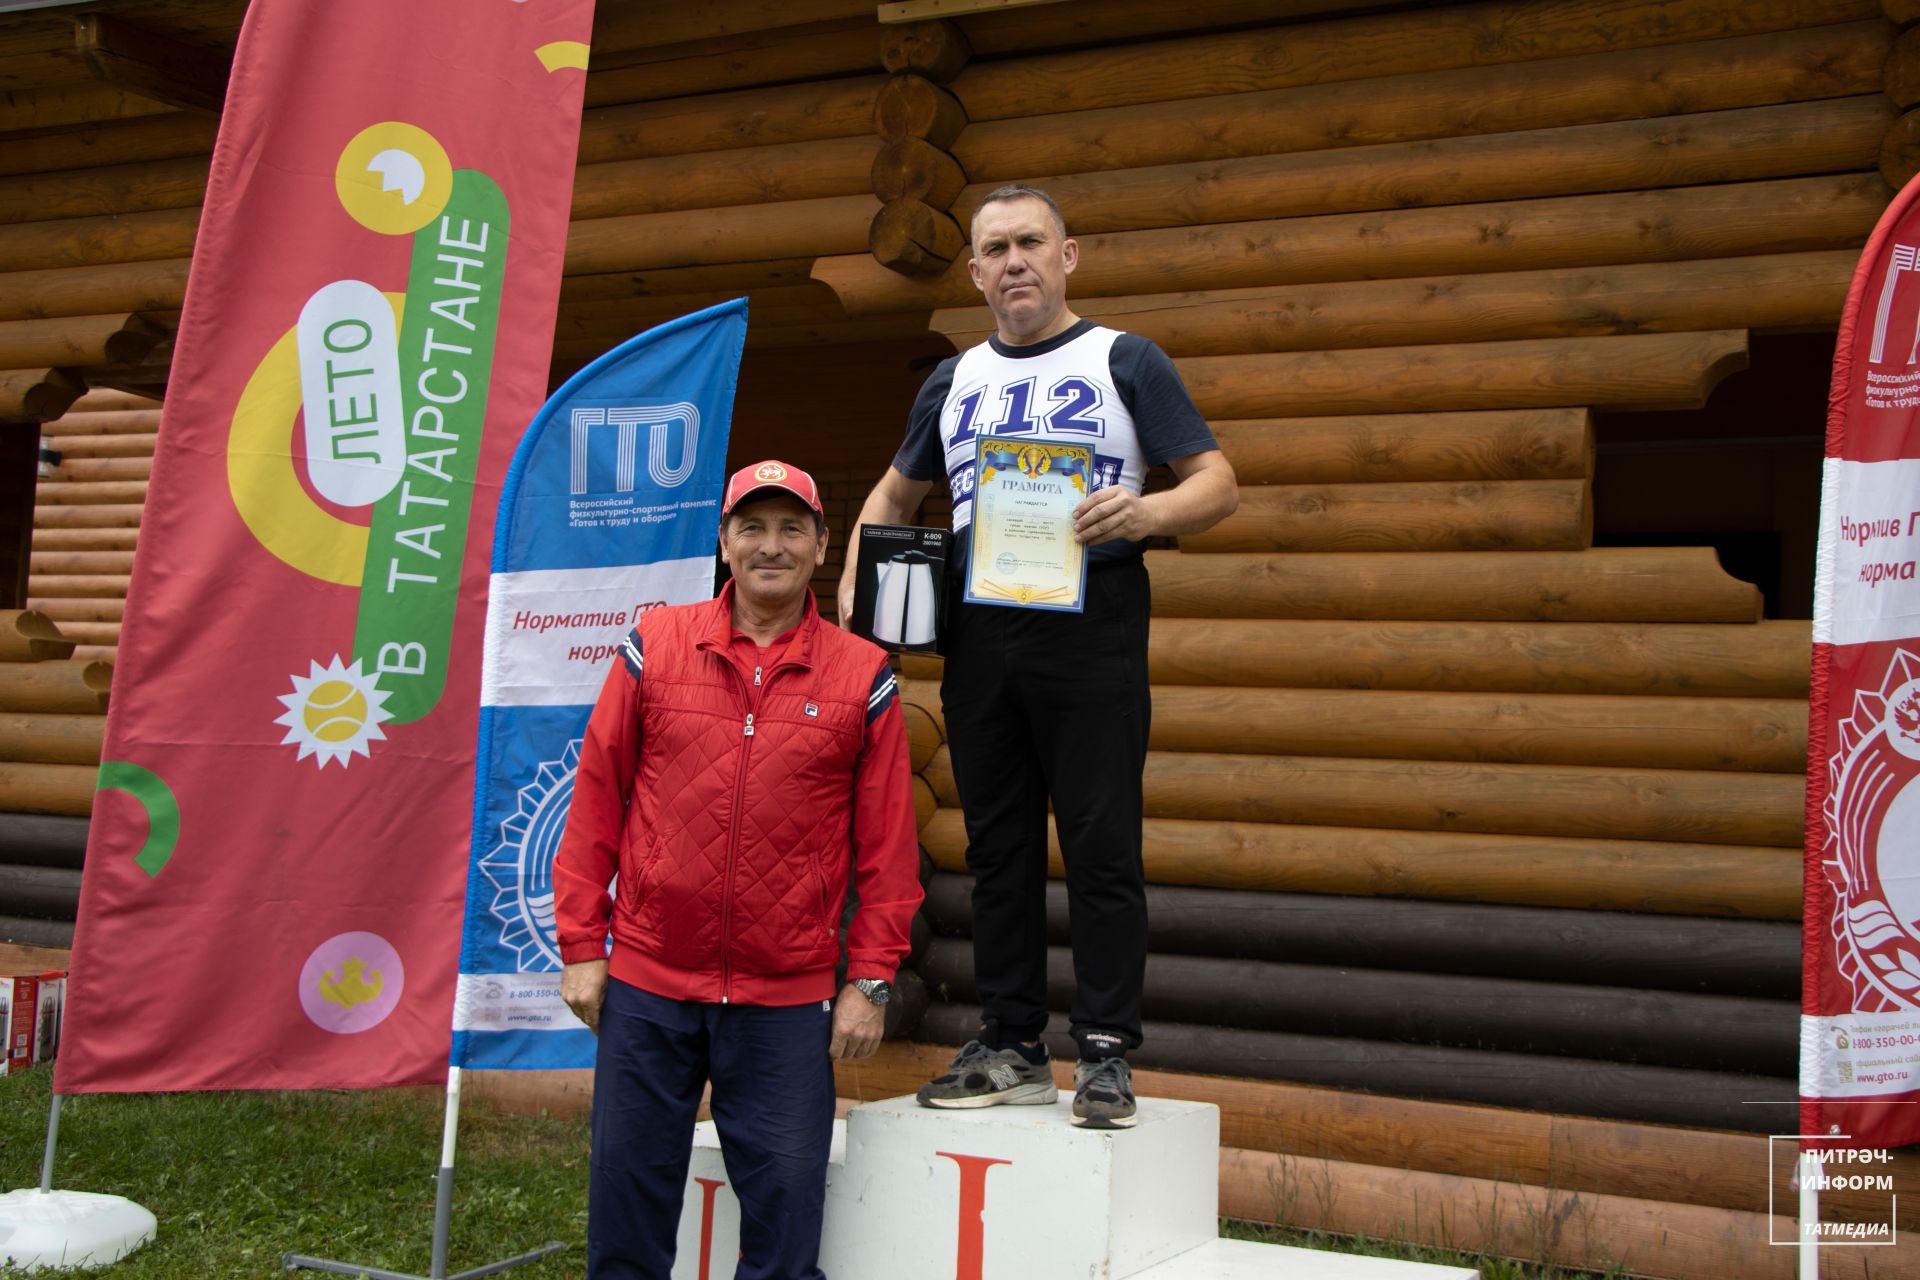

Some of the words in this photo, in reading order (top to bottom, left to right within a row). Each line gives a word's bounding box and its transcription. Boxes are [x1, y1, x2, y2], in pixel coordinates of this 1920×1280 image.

[323, 318, 381, 464] ЛЕТО
[387, 215, 490, 593] ТАТАРСТАНЕ
[947, 375, 1106, 455] 112
[570, 401, 701, 495] ГТО
[1001, 478, 1064, 495] ГРАМОТА
[569, 497, 634, 509] Всероссийский
[569, 501, 679, 519] физкультурно-спортивный
[680, 498, 717, 509] комплекс
[569, 517, 598, 527] «Готов
[599, 518, 605, 527] к
[606, 515, 631, 528] труду
[633, 516, 639, 524] и
[641, 511, 677, 524] обороне»
[1858, 560, 1917, 589] норма
[513, 610, 627, 634] Норматив
[377, 640, 427, 676] В
